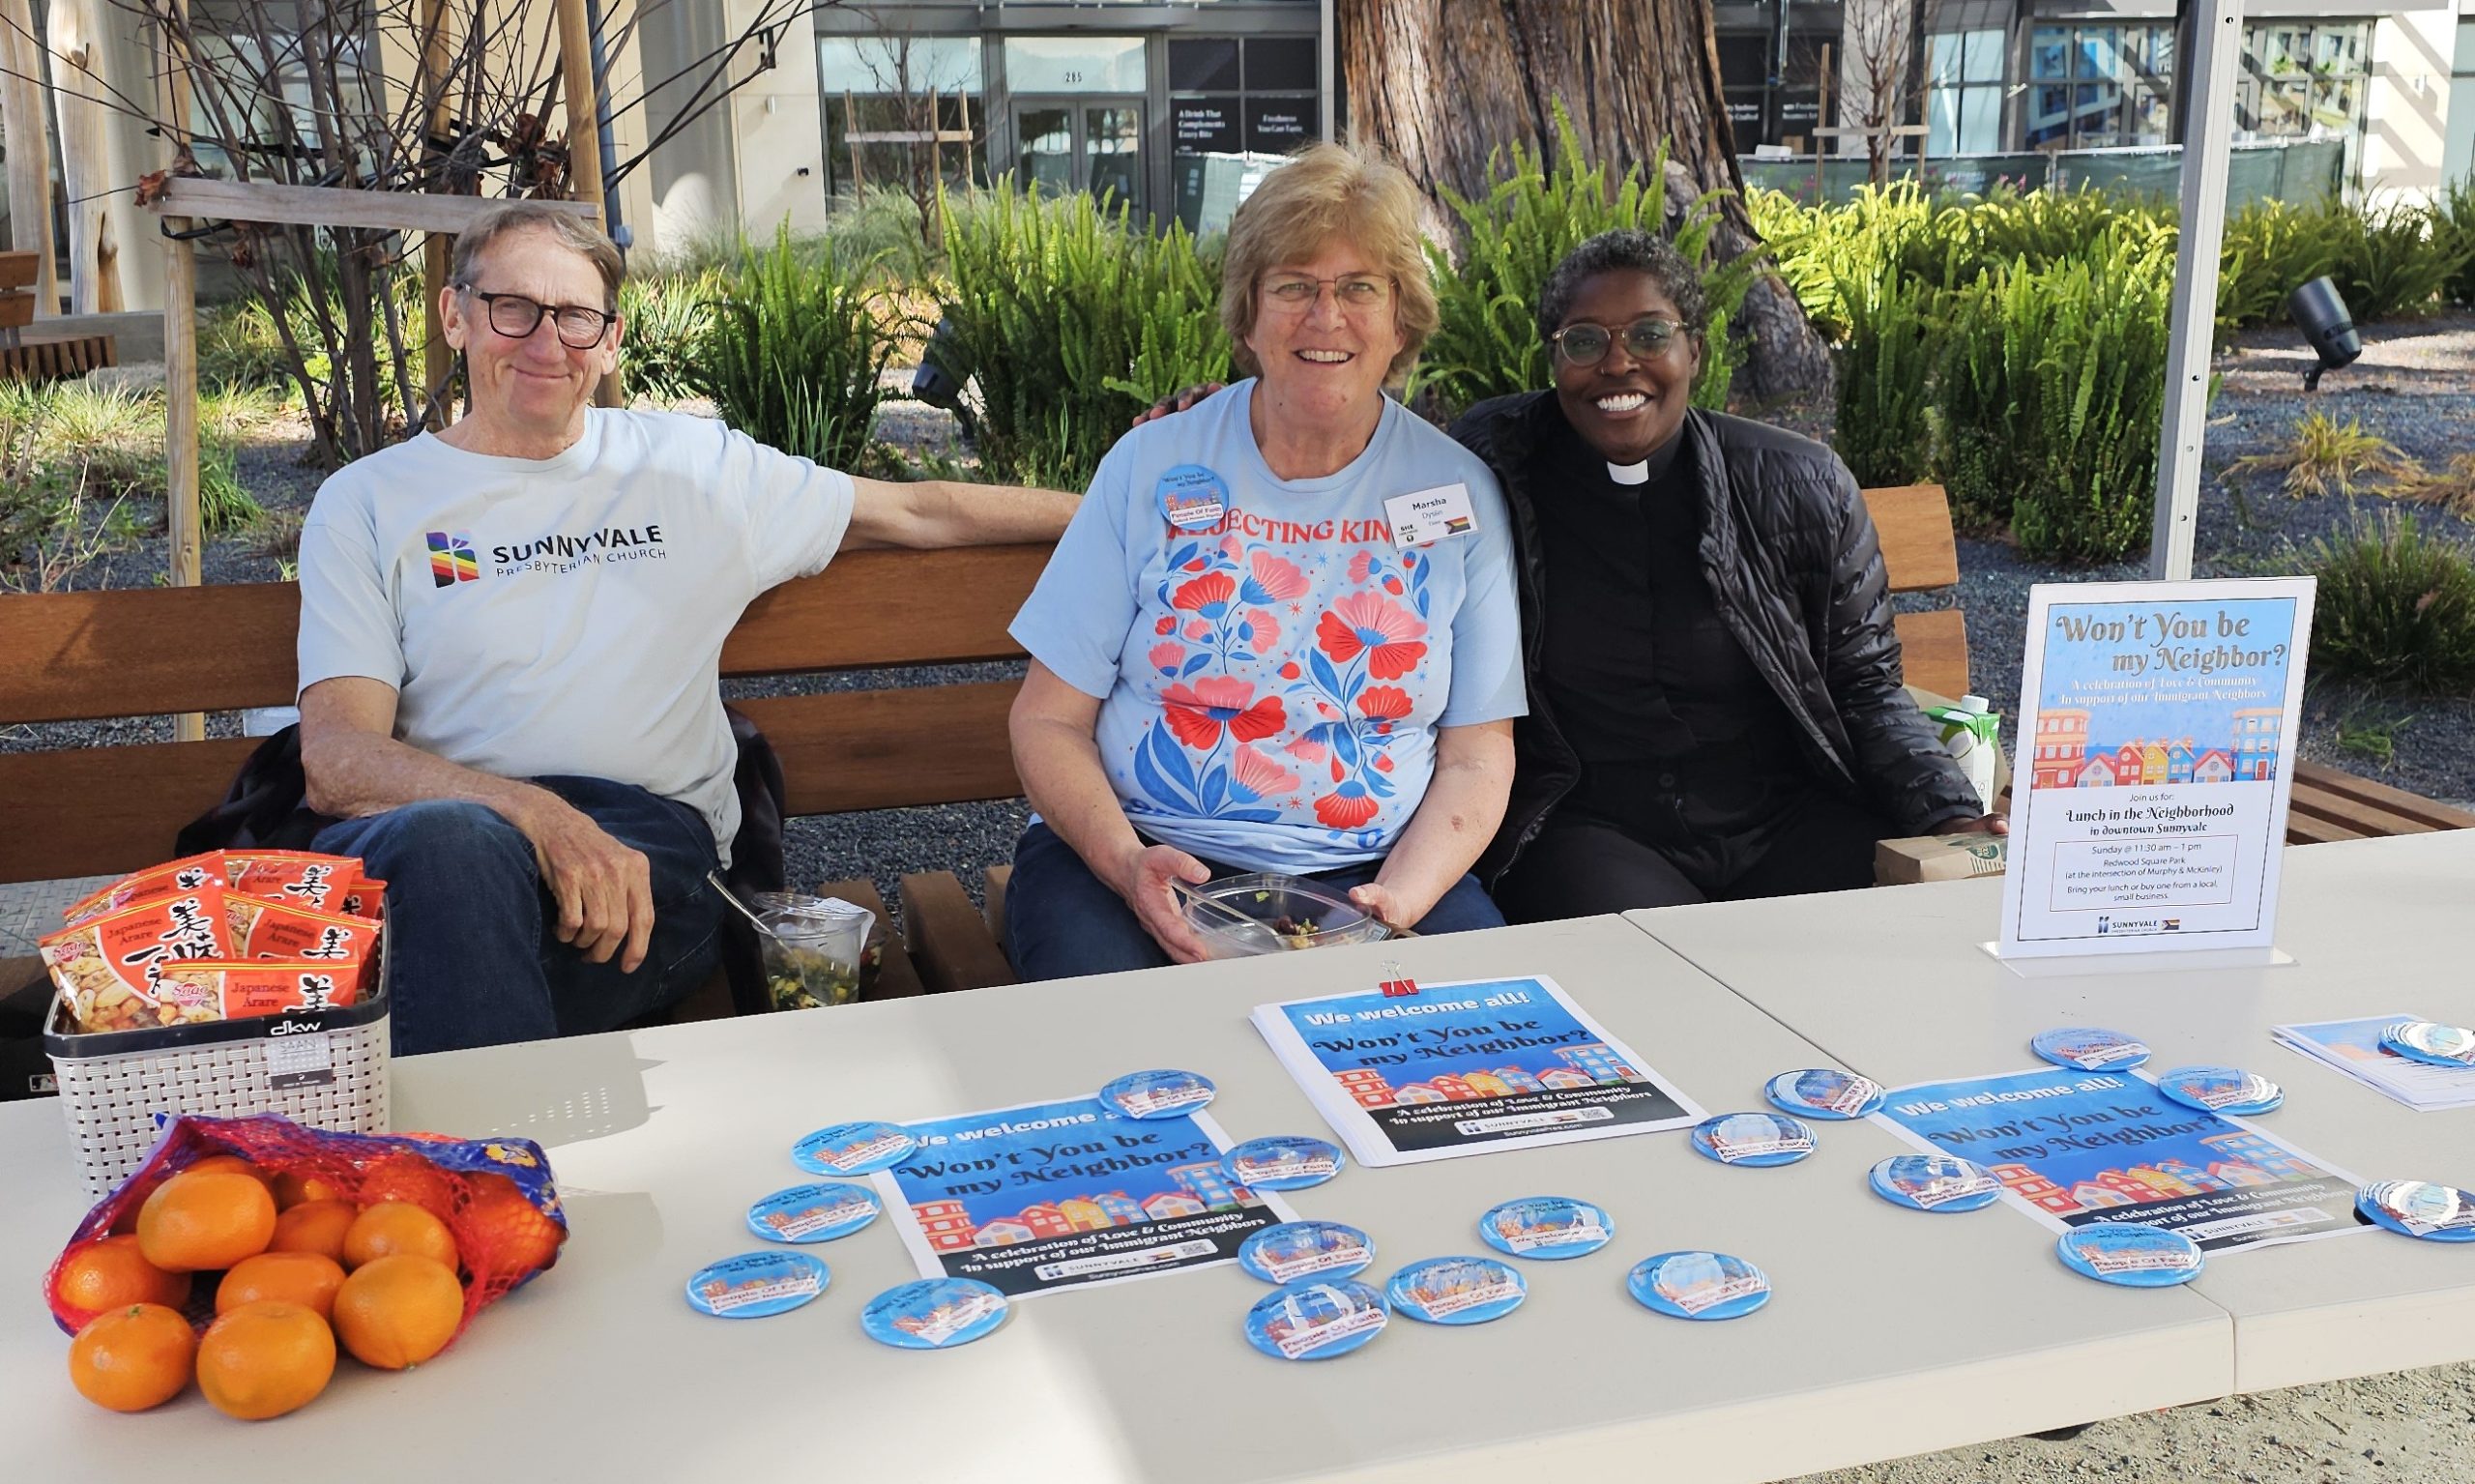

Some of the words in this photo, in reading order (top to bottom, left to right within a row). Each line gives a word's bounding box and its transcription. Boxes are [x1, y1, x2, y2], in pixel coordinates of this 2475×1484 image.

[1065, 72, 1082, 82] 285
[1412, 498, 1446, 510] Marsha
[493, 525, 663, 564] SUNNYVALE
[497, 553, 600, 576] PRESBYTERIAN
[607, 548, 666, 563] CHURCH
[2056, 614, 2146, 643] Won't
[2151, 612, 2207, 648] You
[2217, 611, 2251, 638] be
[2112, 653, 2148, 676] my
[2154, 644, 2286, 675] Neighbor?
[2083, 679, 2141, 690] celebration
[2144, 679, 2155, 690] of
[2160, 678, 2183, 688] Love
[2187, 677, 2196, 686] &
[2198, 676, 2257, 687] Community
[2060, 694, 2072, 705] In
[2075, 693, 2115, 706] support
[2118, 693, 2128, 704] of
[2131, 694, 2148, 703] our
[2152, 691, 2209, 703] Immigrant
[2211, 689, 2267, 701] Neighbors
[2129, 793, 2147, 802] Join
[2160, 792, 2174, 801] for:
[2066, 808, 2106, 823] Lunch
[2109, 809, 2120, 821] in
[2124, 807, 2142, 820] the
[2146, 803, 2234, 821] Neighborhood
[2090, 826, 2099, 836] in
[2102, 825, 2155, 836] downtown
[2156, 822, 2207, 835] Sunnyvale
[2092, 845, 2122, 856] Sunday
[2124, 845, 2133, 854] @
[2104, 858, 2140, 867] Redwood
[2141, 858, 2168, 866] Square
[2091, 869, 2137, 879] intersection
[2148, 868, 2176, 877] Murphy
[2067, 886, 2087, 894] Bring
[2089, 886, 2106, 894] your
[2108, 884, 2128, 892] lunch
[2114, 892, 2134, 901] small
[107, 917, 162, 939] Japanese
[264, 919, 316, 938] Japanese
[2112, 920, 2158, 929] SUNNYVALE
[120, 929, 153, 946] Arare
[268, 932, 300, 946] Arare
[231, 982, 290, 994] Japanese
[243, 998, 278, 1007] Arare
[1306, 1012, 1353, 1026] We
[1356, 997, 1480, 1022] welcome
[1484, 991, 1531, 1007] all!
[271, 1021, 321, 1036] dkw
[1313, 1031, 1423, 1054] Won't
[1423, 1025, 1496, 1044] You
[1500, 1018, 1545, 1031] be
[1355, 1052, 1408, 1065] my
[1413, 1029, 1589, 1060] Neighbor?
[1410, 1111, 1464, 1123] support
[1506, 1098, 1581, 1113] Immigrant
[1581, 1091, 1653, 1105] Neighbors
[1413, 1102, 1488, 1116] celebration
[1504, 1095, 1540, 1105] Love
[1556, 1086, 1631, 1100] Community
[1895, 1099, 1949, 1117] We
[1949, 1084, 2075, 1109] welcome
[2075, 1076, 2126, 1093] all!
[954, 1113, 1097, 1142] welcome
[1928, 1120, 2045, 1146] Won't
[2045, 1112, 2109, 1134] You
[2110, 1103, 2164, 1118] be
[1993, 1142, 2049, 1159] my
[2050, 1114, 2225, 1150] Neighbor?
[897, 1151, 1022, 1179] Won't
[1026, 1142, 1108, 1166] You
[1113, 1133, 1163, 1148] be
[944, 1178, 1002, 1195] my
[1010, 1142, 1210, 1186] Neighbor?
[2111, 1204, 2187, 1221] celebration
[2186, 1200, 2203, 1210] of
[2200, 1196, 2237, 1207] Love
[2250, 1184, 2326, 1199] Community
[2171, 1213, 2188, 1223] of
[2211, 1199, 2285, 1216] Immigrant
[972, 1253, 987, 1262] A
[990, 1239, 1079, 1259] celebration
[1081, 1235, 1097, 1248] of
[1098, 1228, 1139, 1239] Love
[1142, 1226, 1154, 1235] &
[1158, 1212, 1243, 1233] Community
[2204, 1219, 2266, 1235] SUNNYVALE
[960, 1263, 982, 1273] In
[985, 1255, 1048, 1269] support
[1050, 1248, 1066, 1260] of
[1068, 1246, 1095, 1256] our
[1098, 1232, 1184, 1251] Immigrant
[1185, 1218, 1267, 1237] Neighbors
